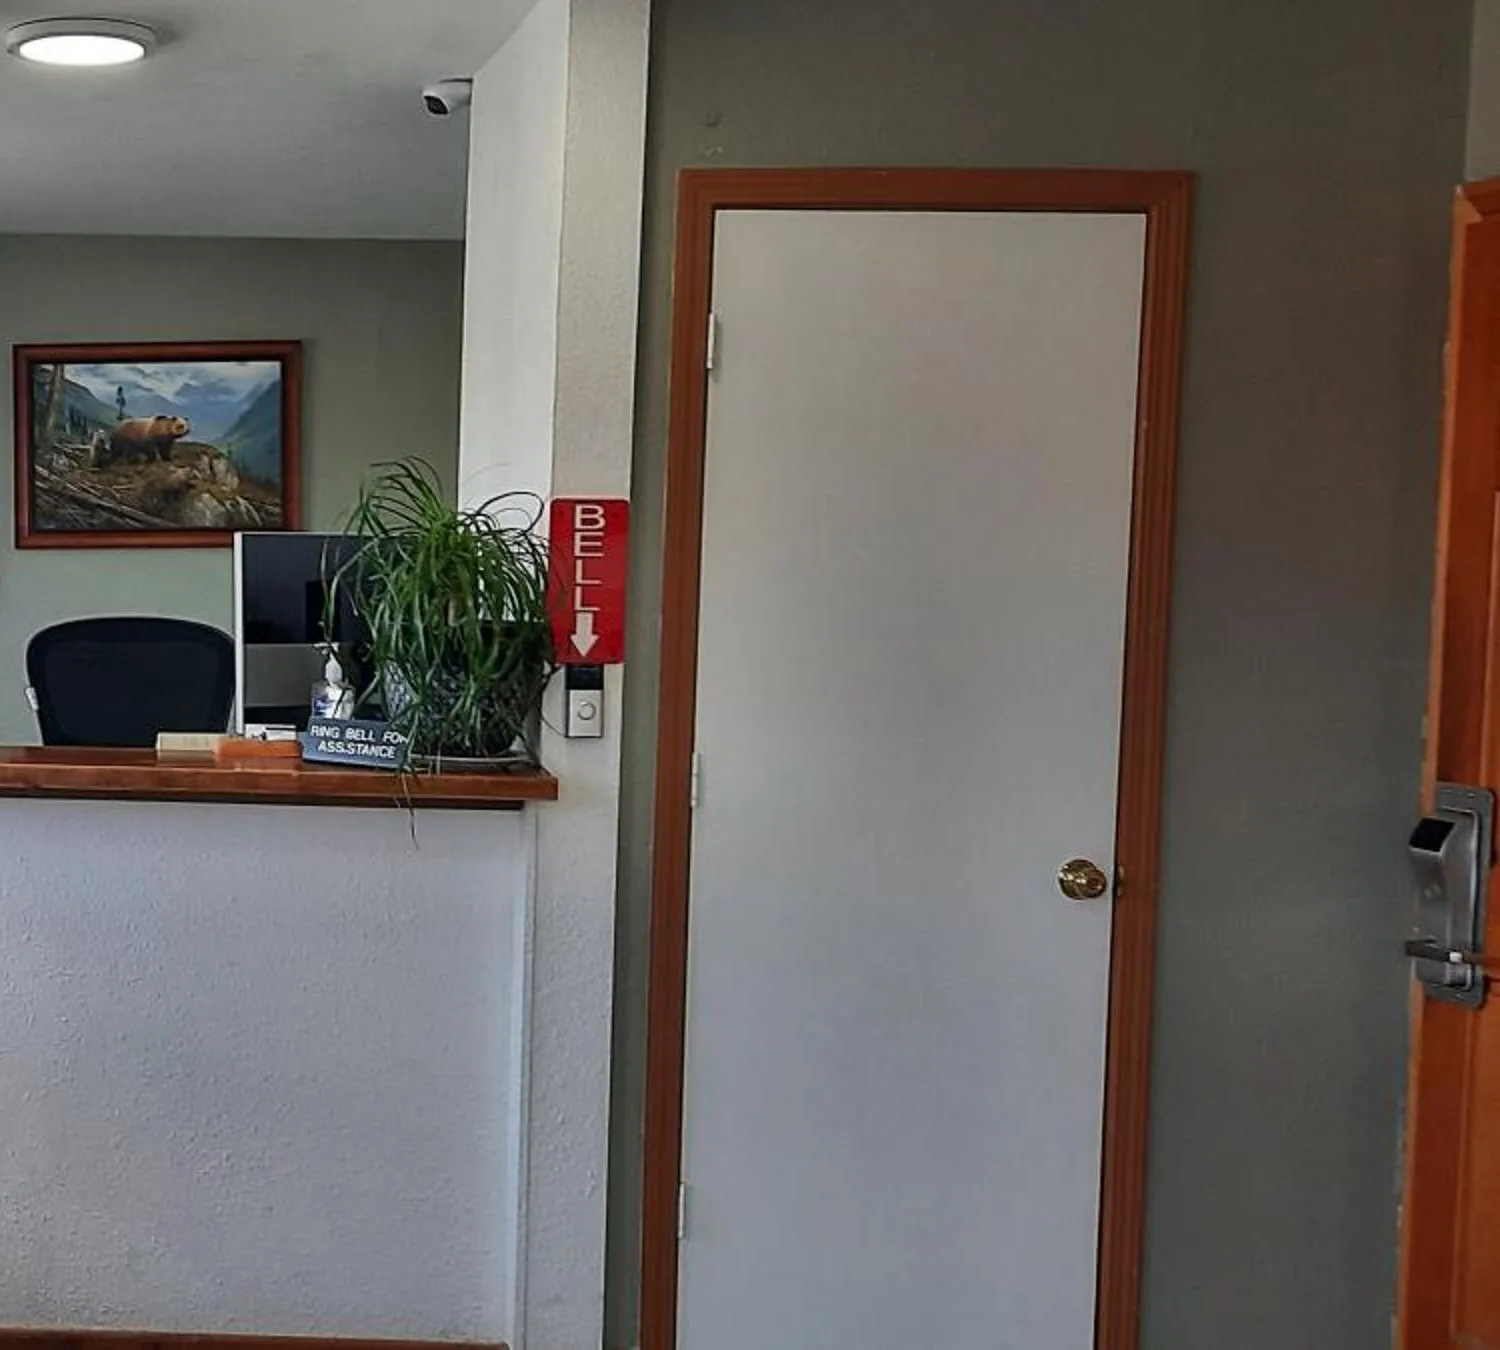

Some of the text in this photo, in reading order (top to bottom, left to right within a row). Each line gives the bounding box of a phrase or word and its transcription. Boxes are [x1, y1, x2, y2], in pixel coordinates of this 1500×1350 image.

[574, 504, 606, 612] BELL
[310, 725, 340, 739] RING
[345, 727, 375, 741] BELL
